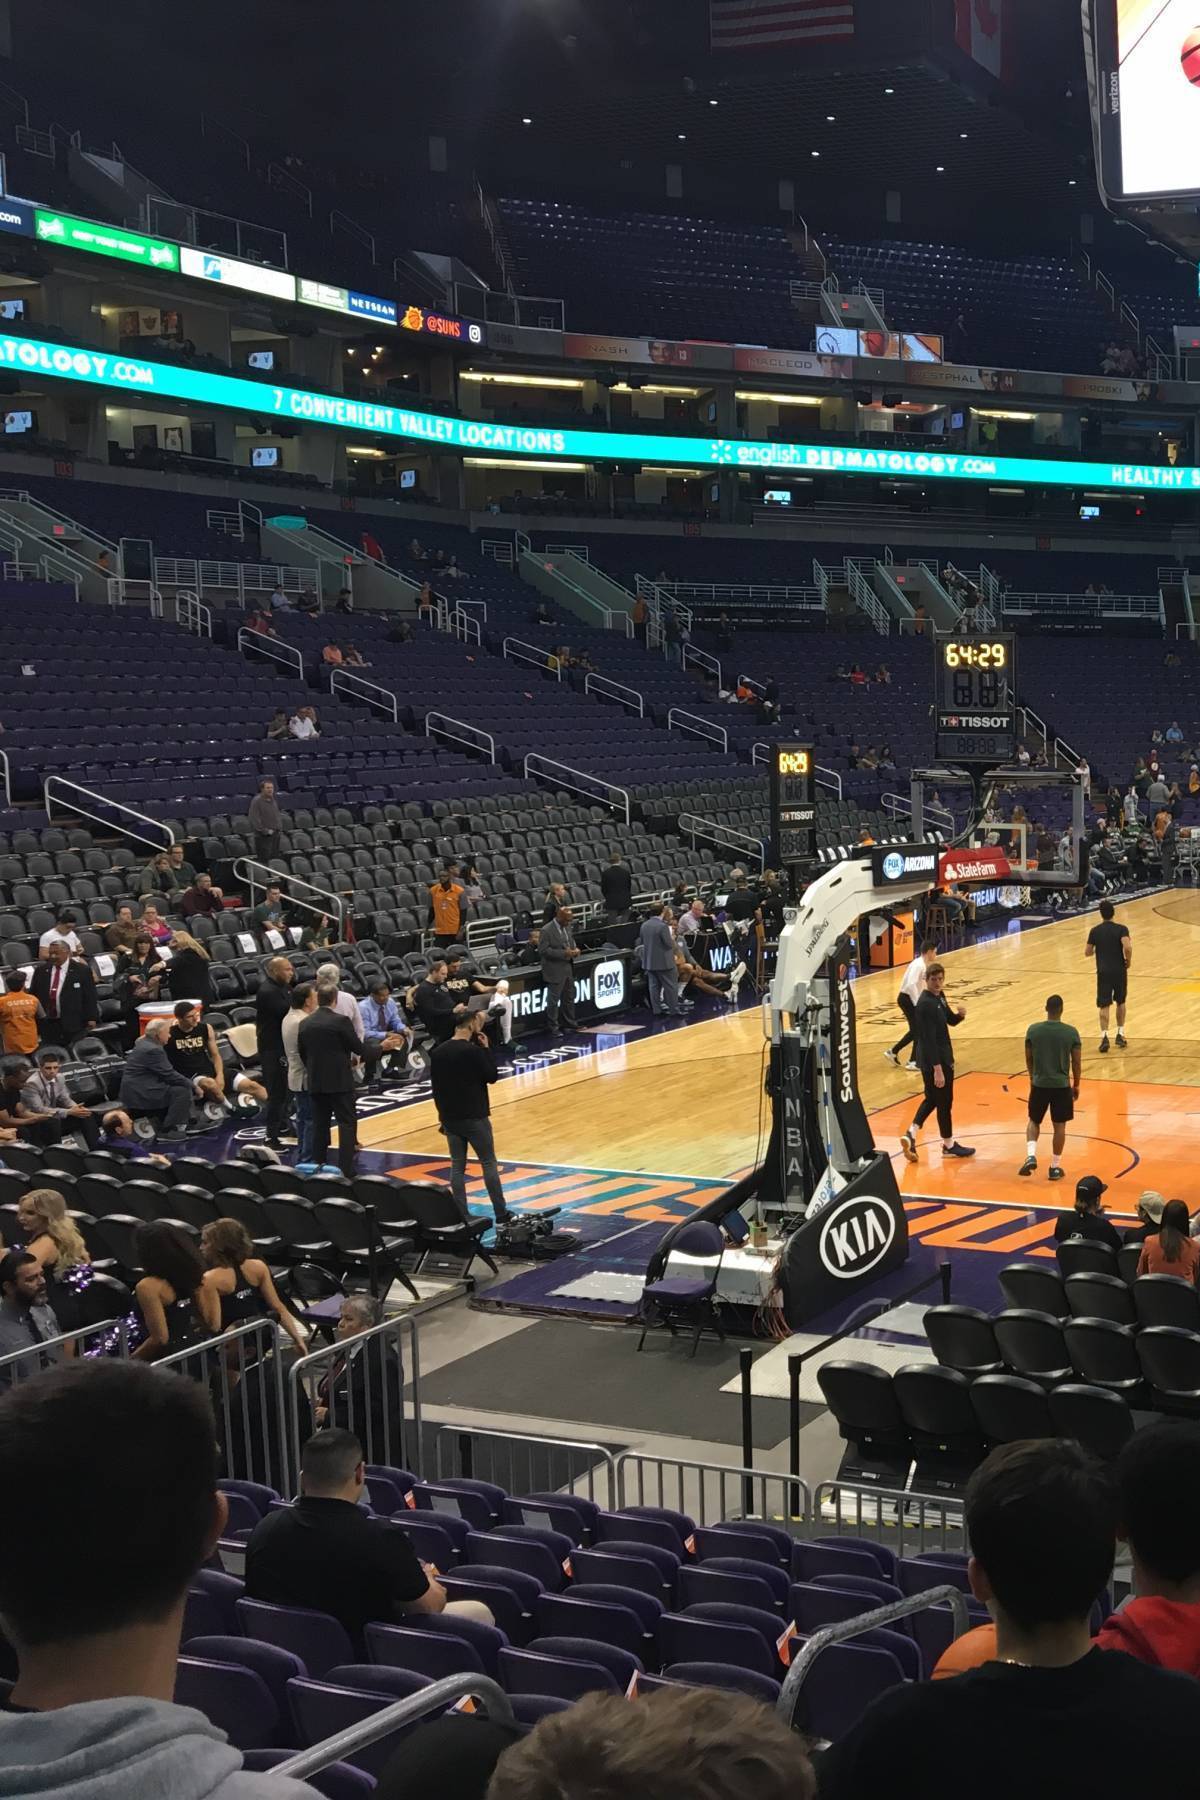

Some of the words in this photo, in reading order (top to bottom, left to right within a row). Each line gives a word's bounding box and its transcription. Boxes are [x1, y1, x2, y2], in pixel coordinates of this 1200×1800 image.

[1109, 71, 1119, 115] verizon
[427, 316, 461, 338] @SUNS
[272, 390, 283, 410] 7
[290, 394, 394, 430] CONVENIENT
[399, 414, 453, 441] VALLEY
[459, 421, 565, 452] LOCATIONS
[737, 443, 801, 467] english
[1112, 466, 1184, 486] HEALTHY
[946, 643, 1005, 667] 64:29
[959, 717, 1010, 728] TISSOT
[790, 810, 814, 821] TISSOT
[904, 855, 935, 872] ARIZONA
[597, 971, 621, 991] FOX
[597, 987, 621, 999] SPORTS
[175, 1036, 203, 1050] BUCKS
[837, 978, 854, 1103] Southwest
[829, 1208, 887, 1268] KIA
